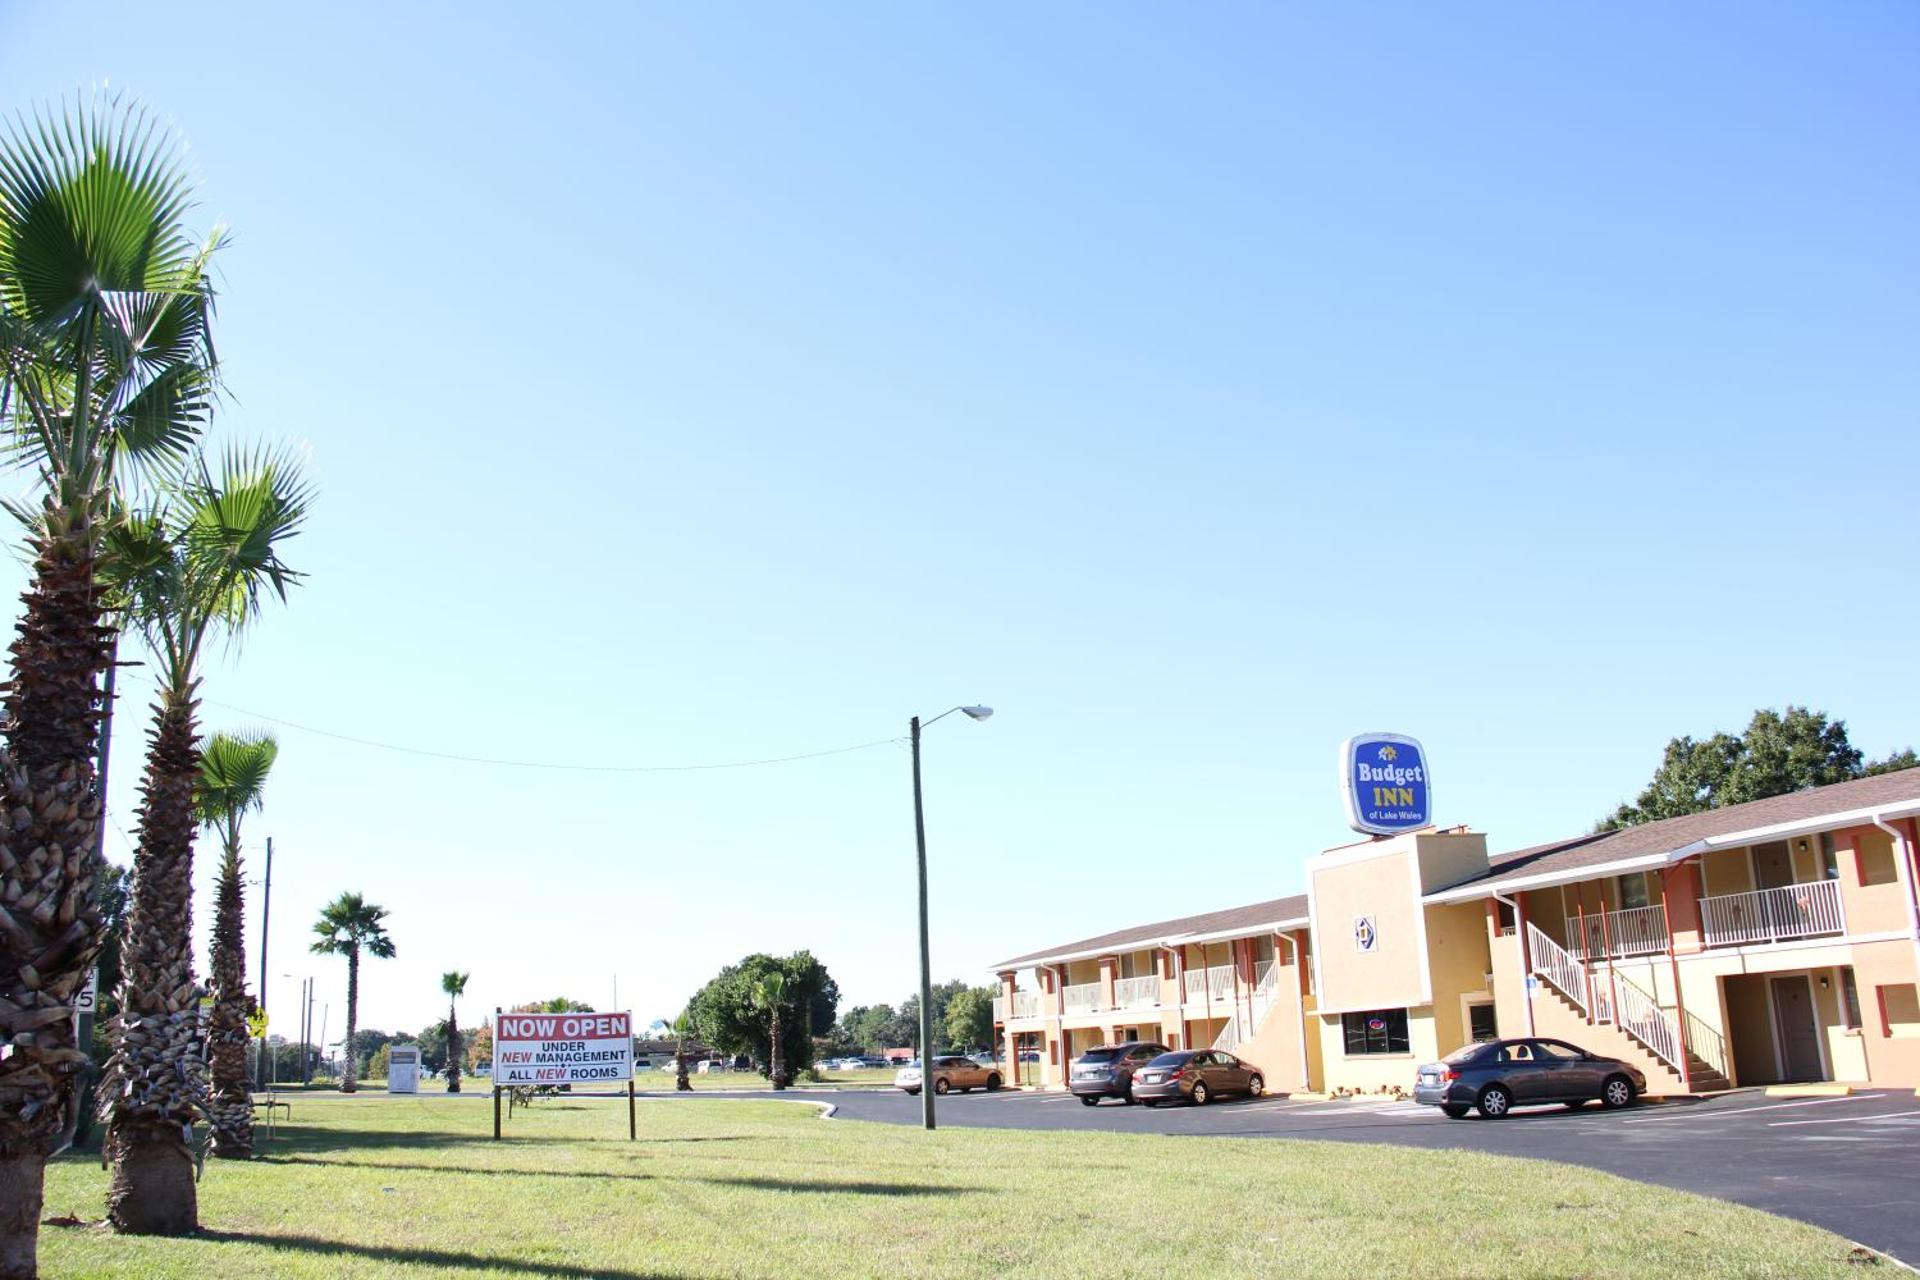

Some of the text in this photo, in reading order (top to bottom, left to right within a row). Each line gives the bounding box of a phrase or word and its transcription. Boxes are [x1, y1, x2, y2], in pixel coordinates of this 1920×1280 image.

[1358, 763, 1422, 786] Budget
[1373, 787, 1414, 807] INN
[1369, 811, 1378, 819] of
[1380, 811, 1399, 819] Lake
[502, 1017, 626, 1038] NOW OPEN
[542, 1042, 586, 1052] UNDER
[501, 1050, 626, 1063] NEW MANAGEMENT
[509, 1067, 618, 1080] ALL NEW ROOMS
